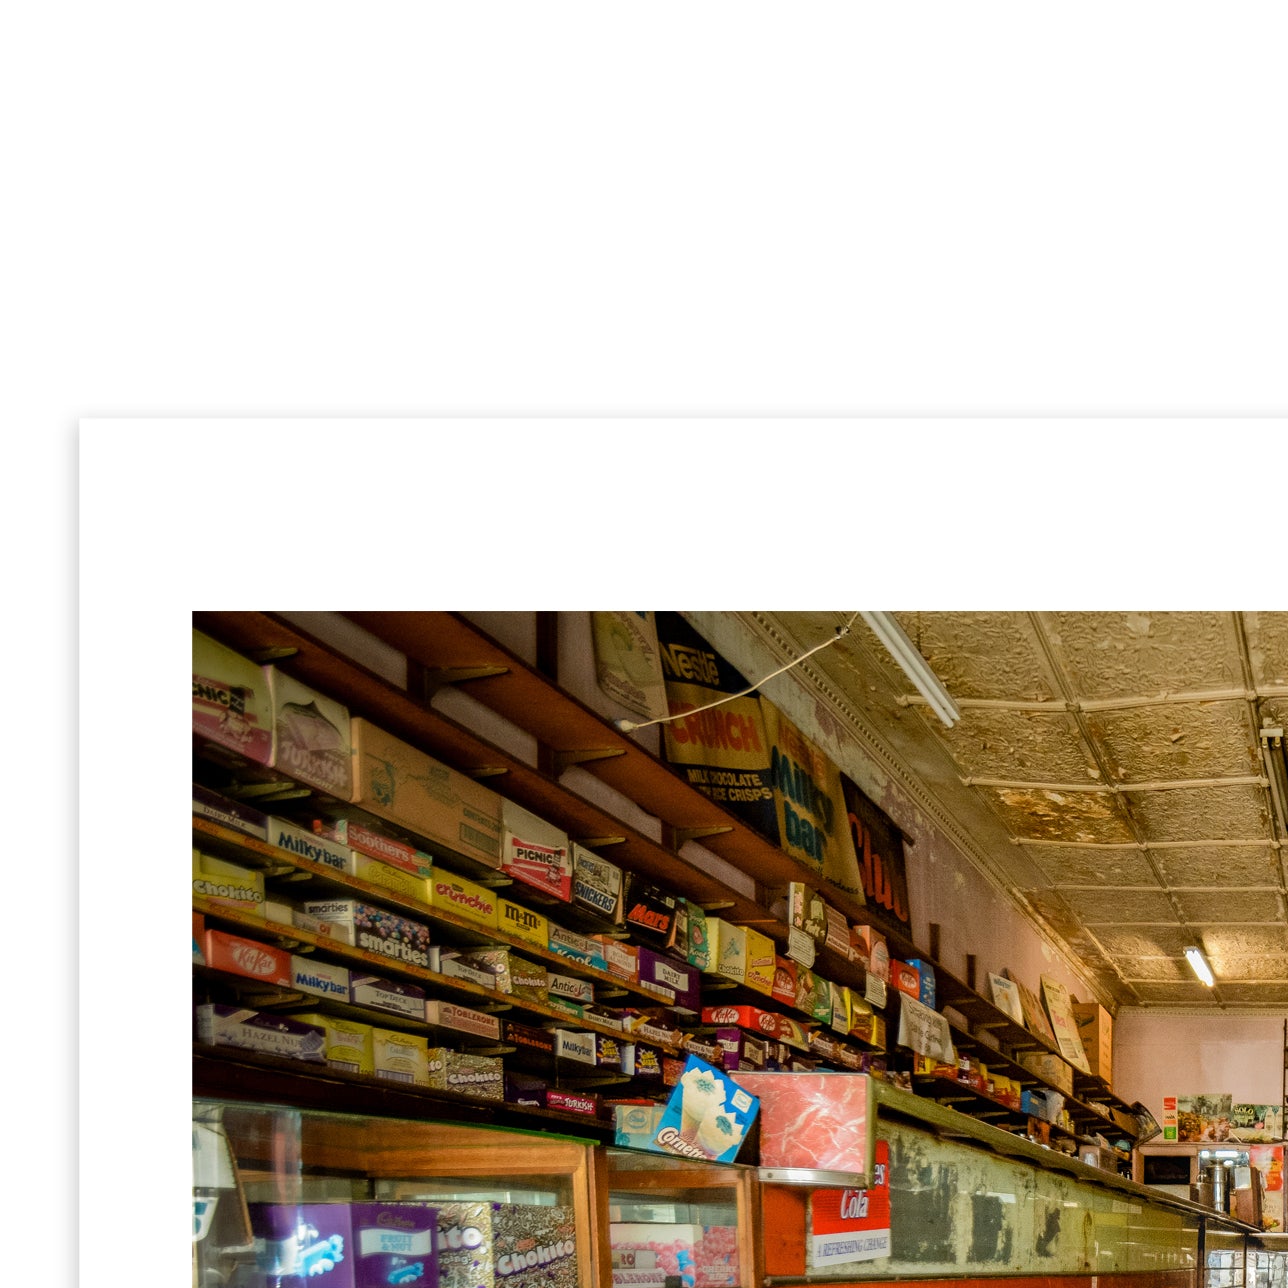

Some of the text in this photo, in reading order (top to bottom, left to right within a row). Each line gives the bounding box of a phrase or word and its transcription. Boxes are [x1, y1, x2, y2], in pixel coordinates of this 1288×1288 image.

[728, 786, 773, 802] CRISPS
[516, 847, 554, 865] PICNIC
[192, 879, 264, 904] Chokito
[575, 881, 614, 912] SNICKERS
[308, 903, 348, 914] smarties
[627, 903, 671, 930] Mars
[359, 932, 429, 971] smarties
[512, 975, 546, 988] Chokito
[451, 1006, 495, 1026] TOBLERONE
[242, 1027, 280, 1044] HAZEL
[449, 1072, 501, 1085] Chokito
[564, 1097, 594, 1111] TURKISH
[840, 1190, 869, 1220] Cola
[380, 1234, 412, 1244] FRUIT
[390, 1242, 412, 1252] NUT
[496, 1238, 576, 1278] Chokito
